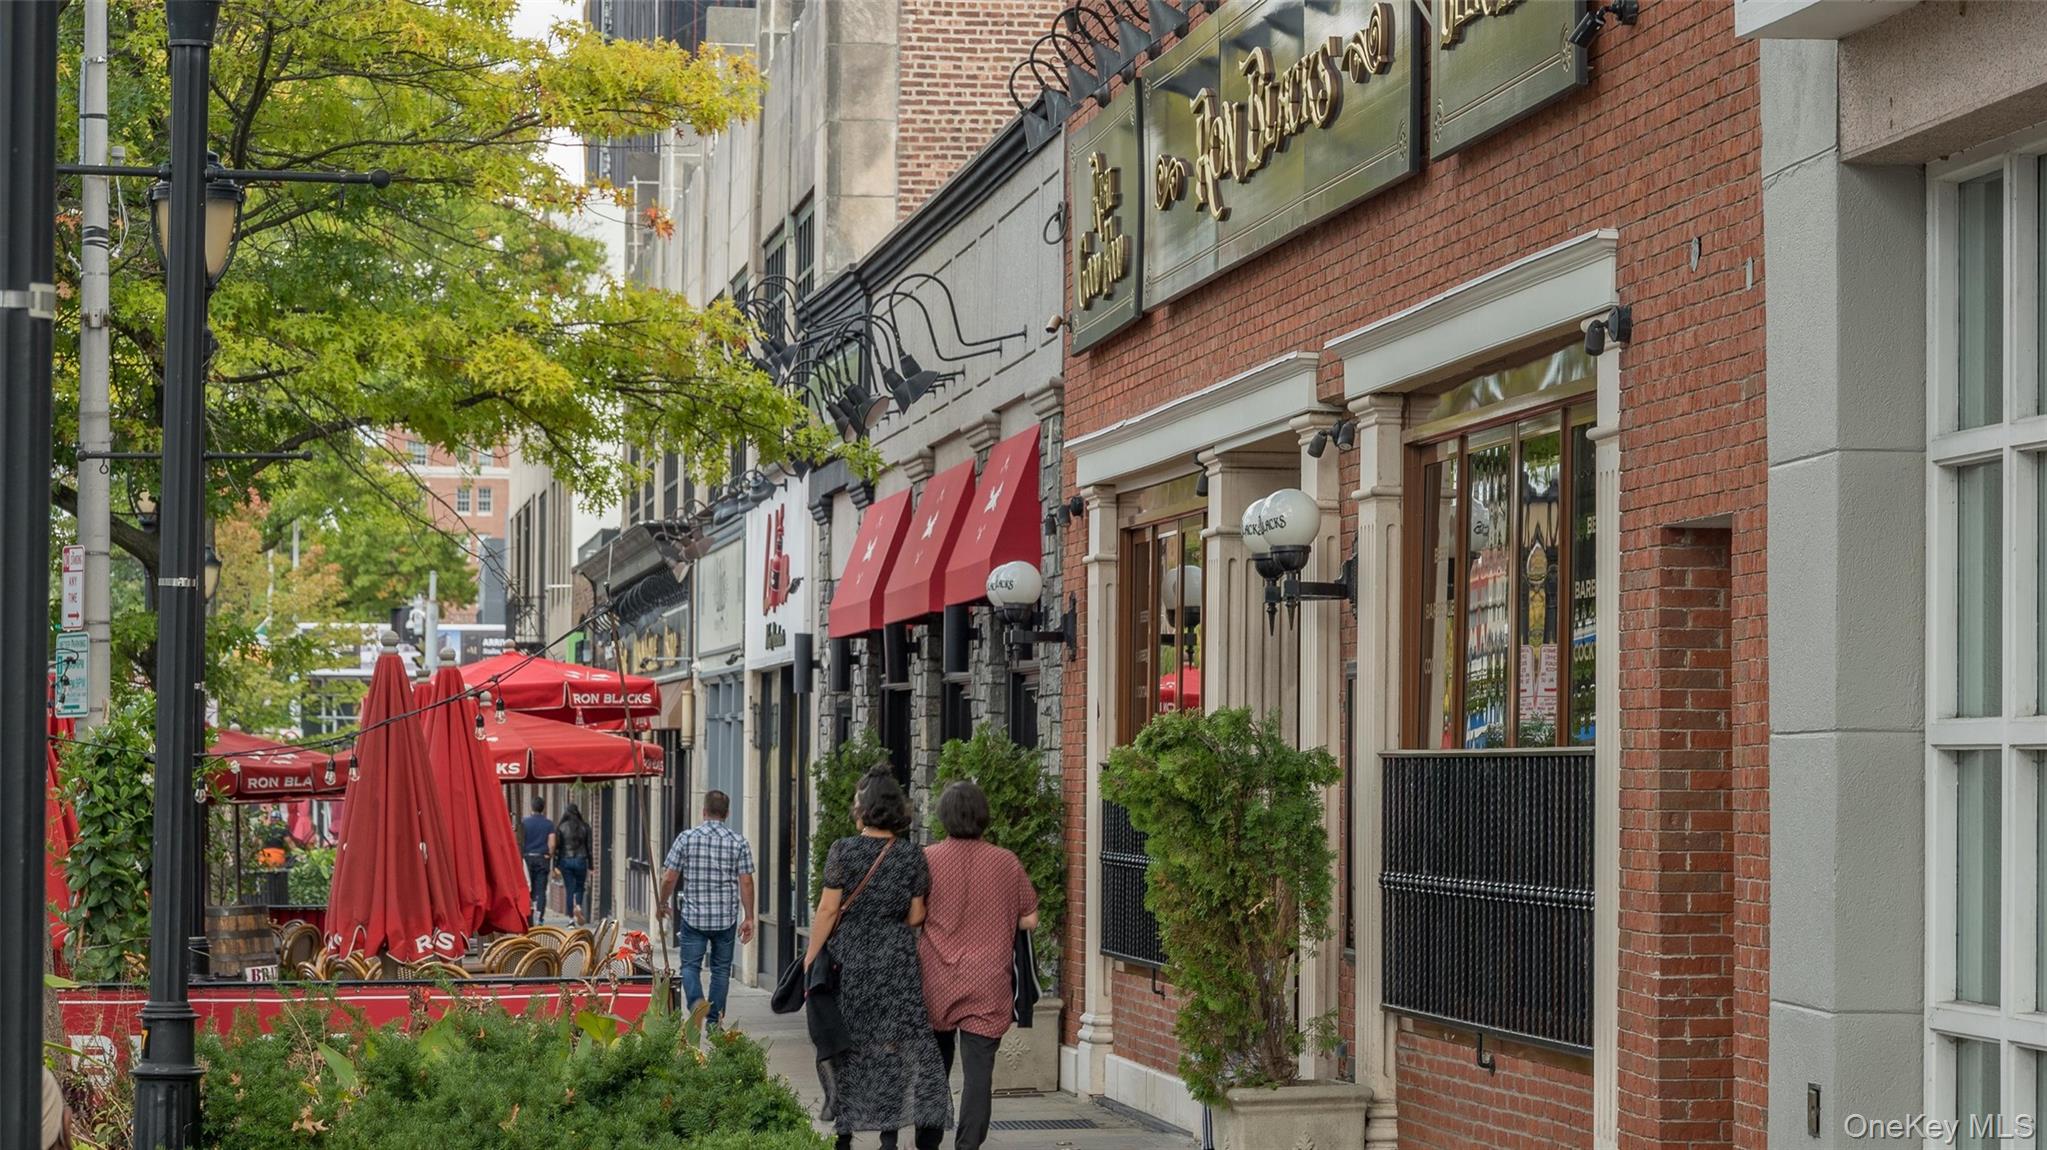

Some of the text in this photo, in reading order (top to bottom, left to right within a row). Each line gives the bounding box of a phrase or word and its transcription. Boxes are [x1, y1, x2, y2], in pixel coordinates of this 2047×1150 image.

[573, 692, 652, 704] RON BLACKS
[496, 763, 521, 774] KS
[248, 776, 312, 789] RON BLA
